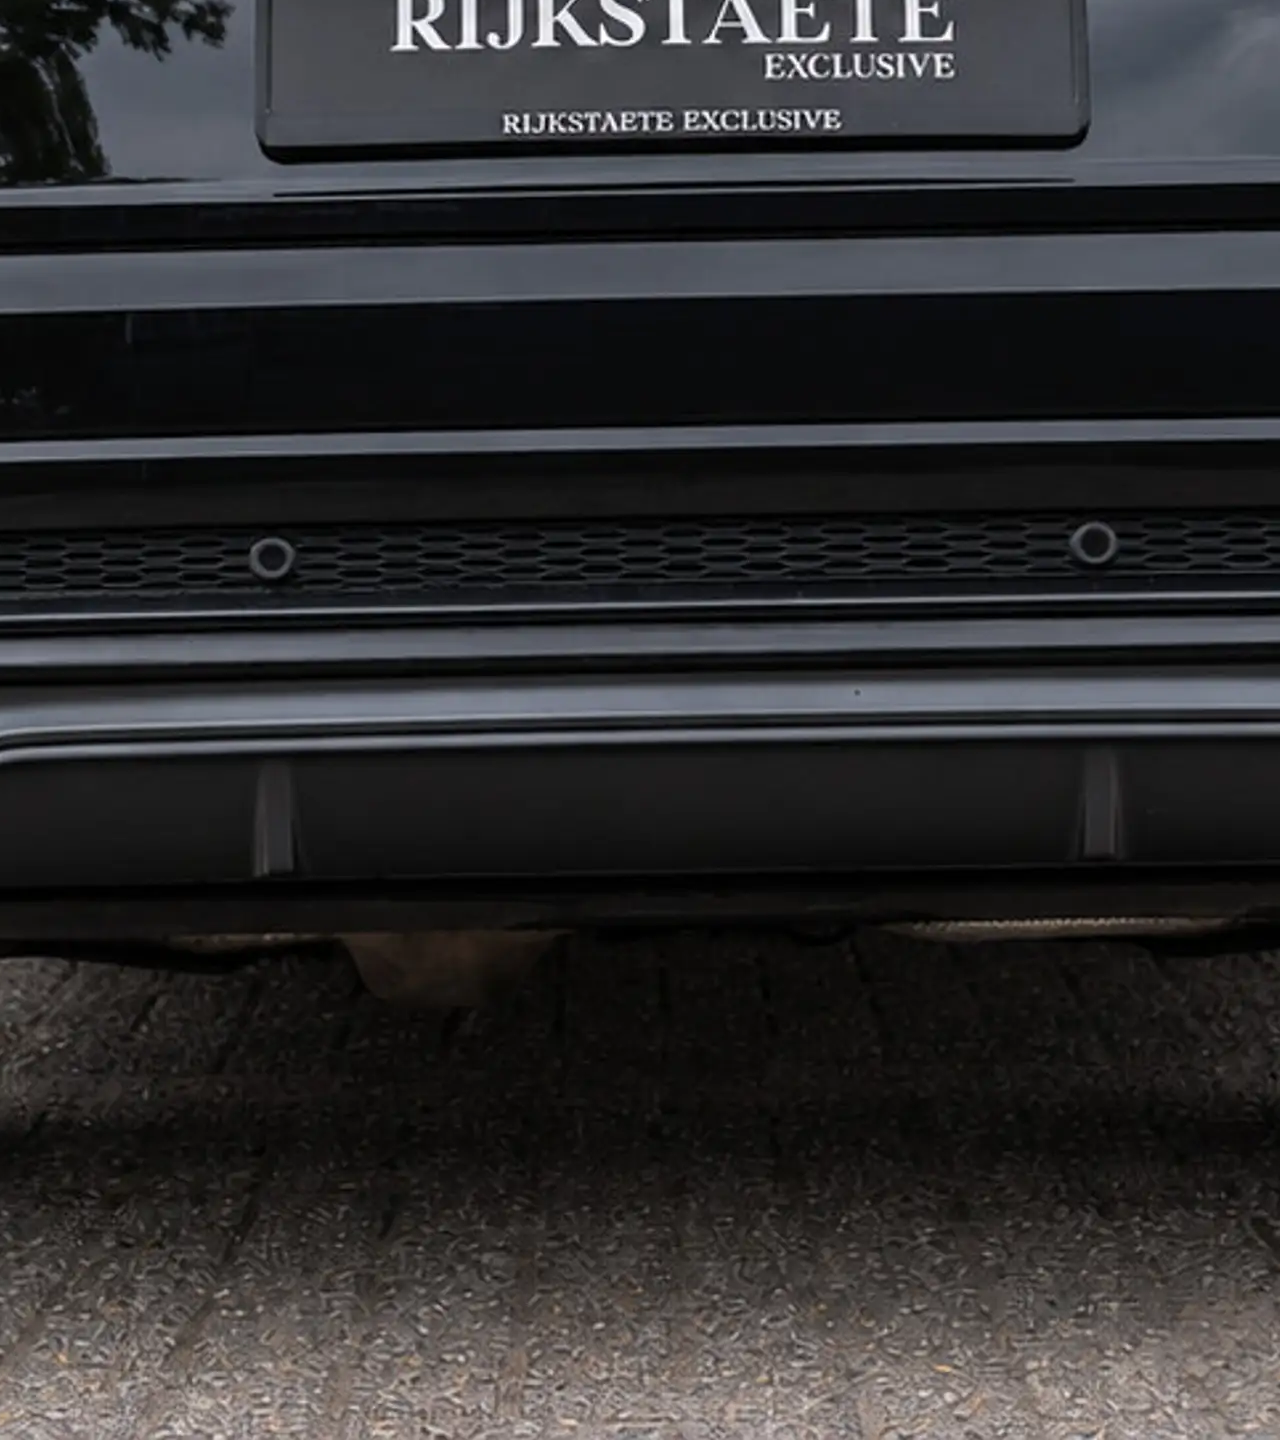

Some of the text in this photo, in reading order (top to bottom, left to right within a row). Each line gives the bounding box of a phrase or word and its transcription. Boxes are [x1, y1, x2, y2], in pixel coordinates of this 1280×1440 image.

[763, 52, 956, 80] EXCLUSIVE
[502, 108, 843, 135] RIJKSTAETE EXCLUSIVE
